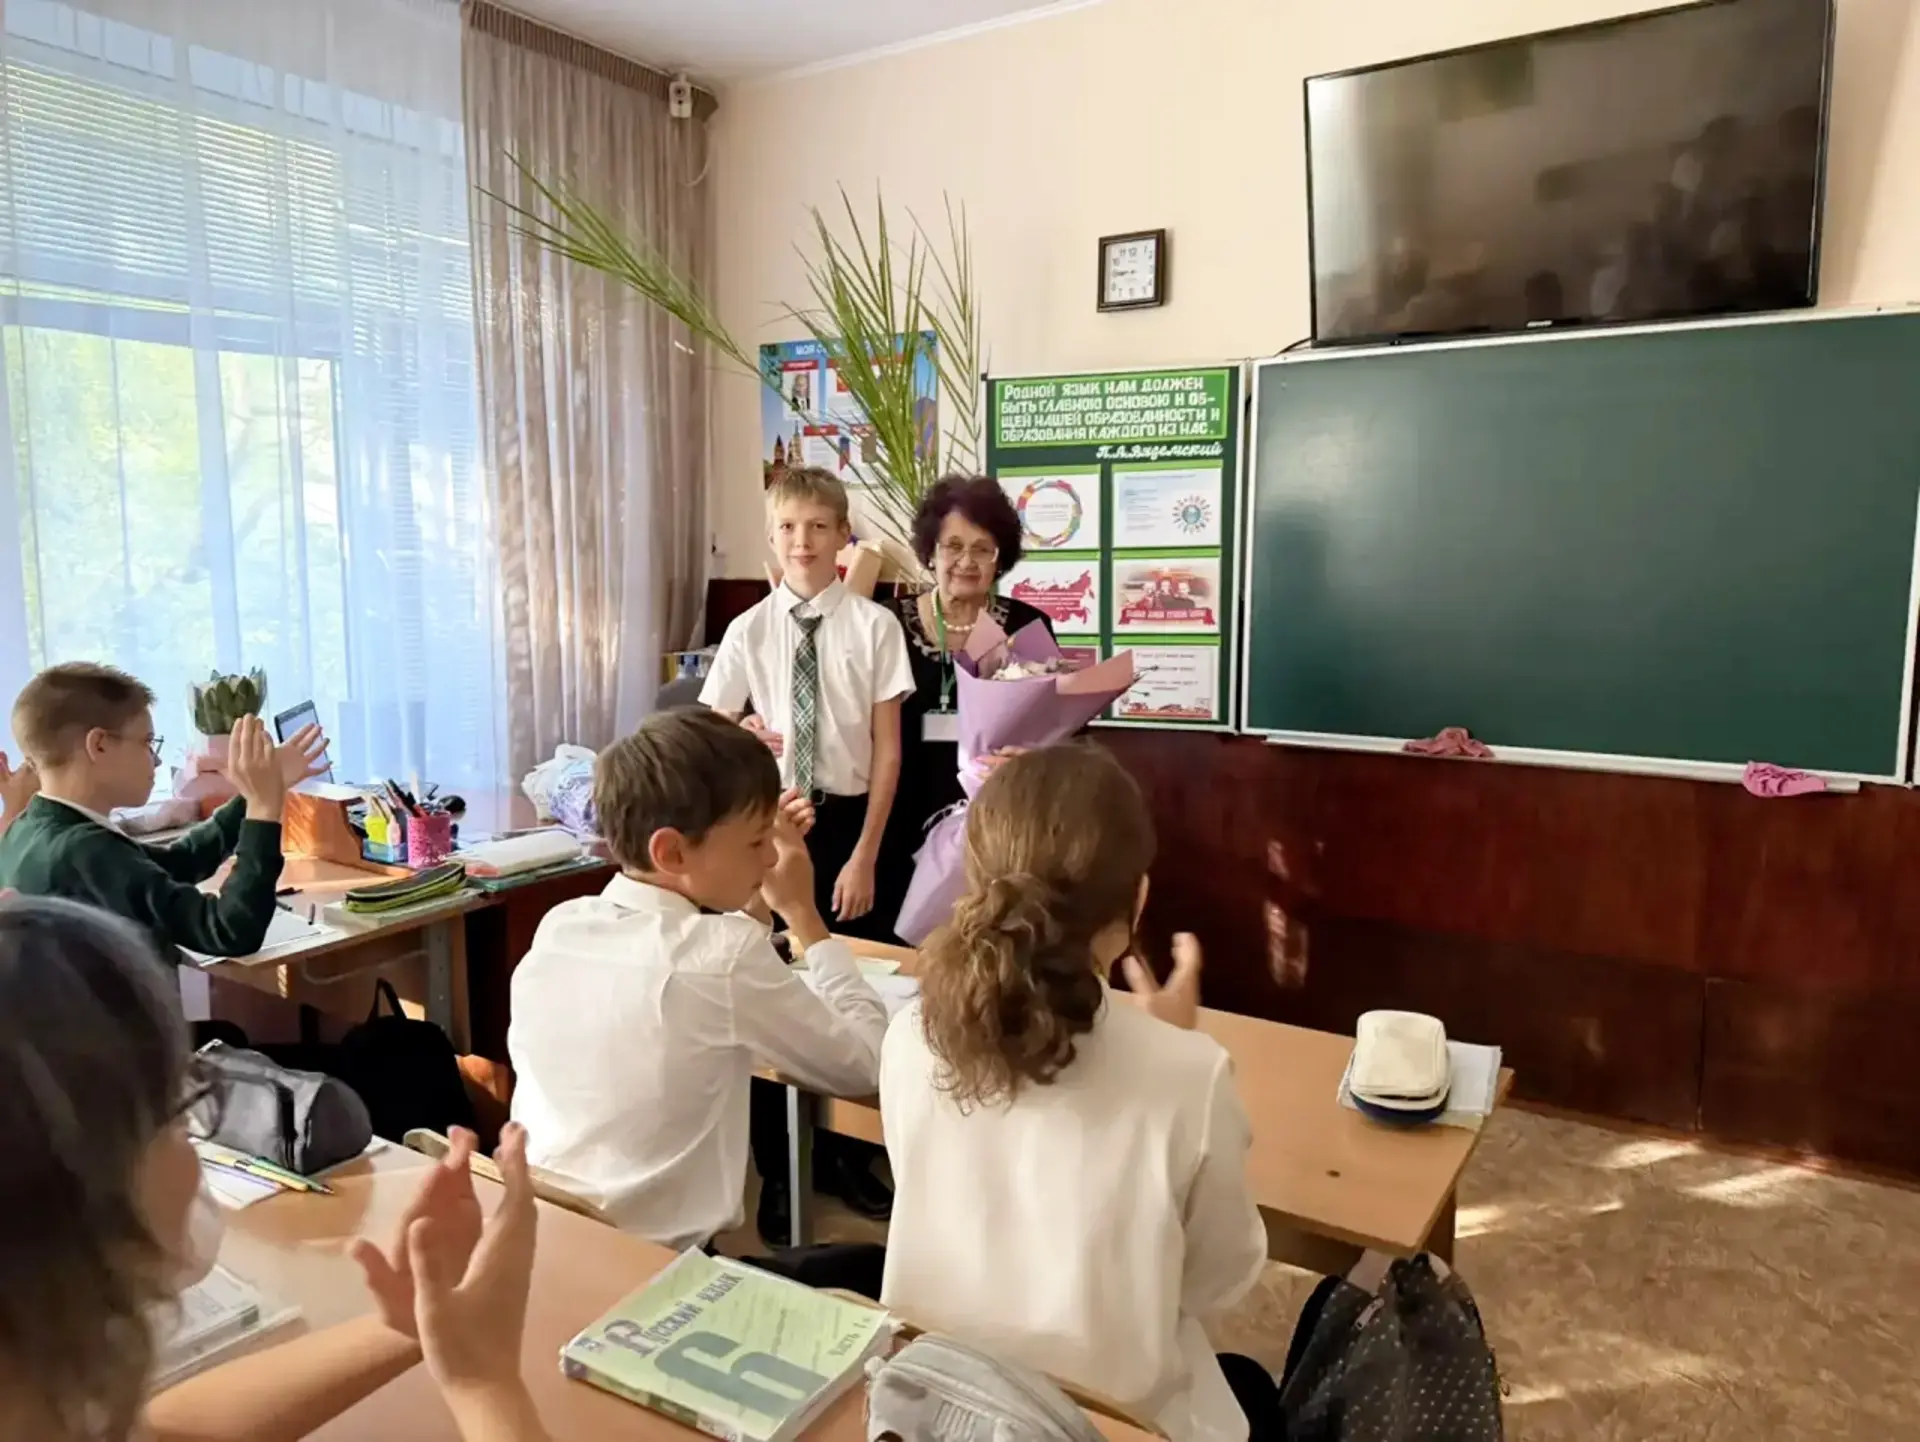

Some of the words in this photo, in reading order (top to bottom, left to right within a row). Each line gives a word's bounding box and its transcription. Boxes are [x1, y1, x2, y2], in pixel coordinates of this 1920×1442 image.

[1062, 381, 1101, 396] ЯЗЫК
[1105, 379, 1137, 394] НАМ
[1141, 376, 1204, 393] ДОЛЖЕН
[1001, 400, 1037, 414] БЫТЬ
[1039, 397, 1102, 413] ГЛАВНОЮ
[1106, 393, 1170, 410] ОСНОВОЮ
[1001, 413, 1032, 429] ЩЕЙ
[1034, 409, 1082, 426] НАШЕЙ
[1084, 407, 1207, 426] ОБРАЗОВАННОСТИ
[1001, 426, 1087, 442] ОБРАЗОВАНИЯ
[1088, 423, 1157, 441] КАЖДОГО
[1158, 422, 1177, 437] ИЗ
[654, 1331, 831, 1420] 6
